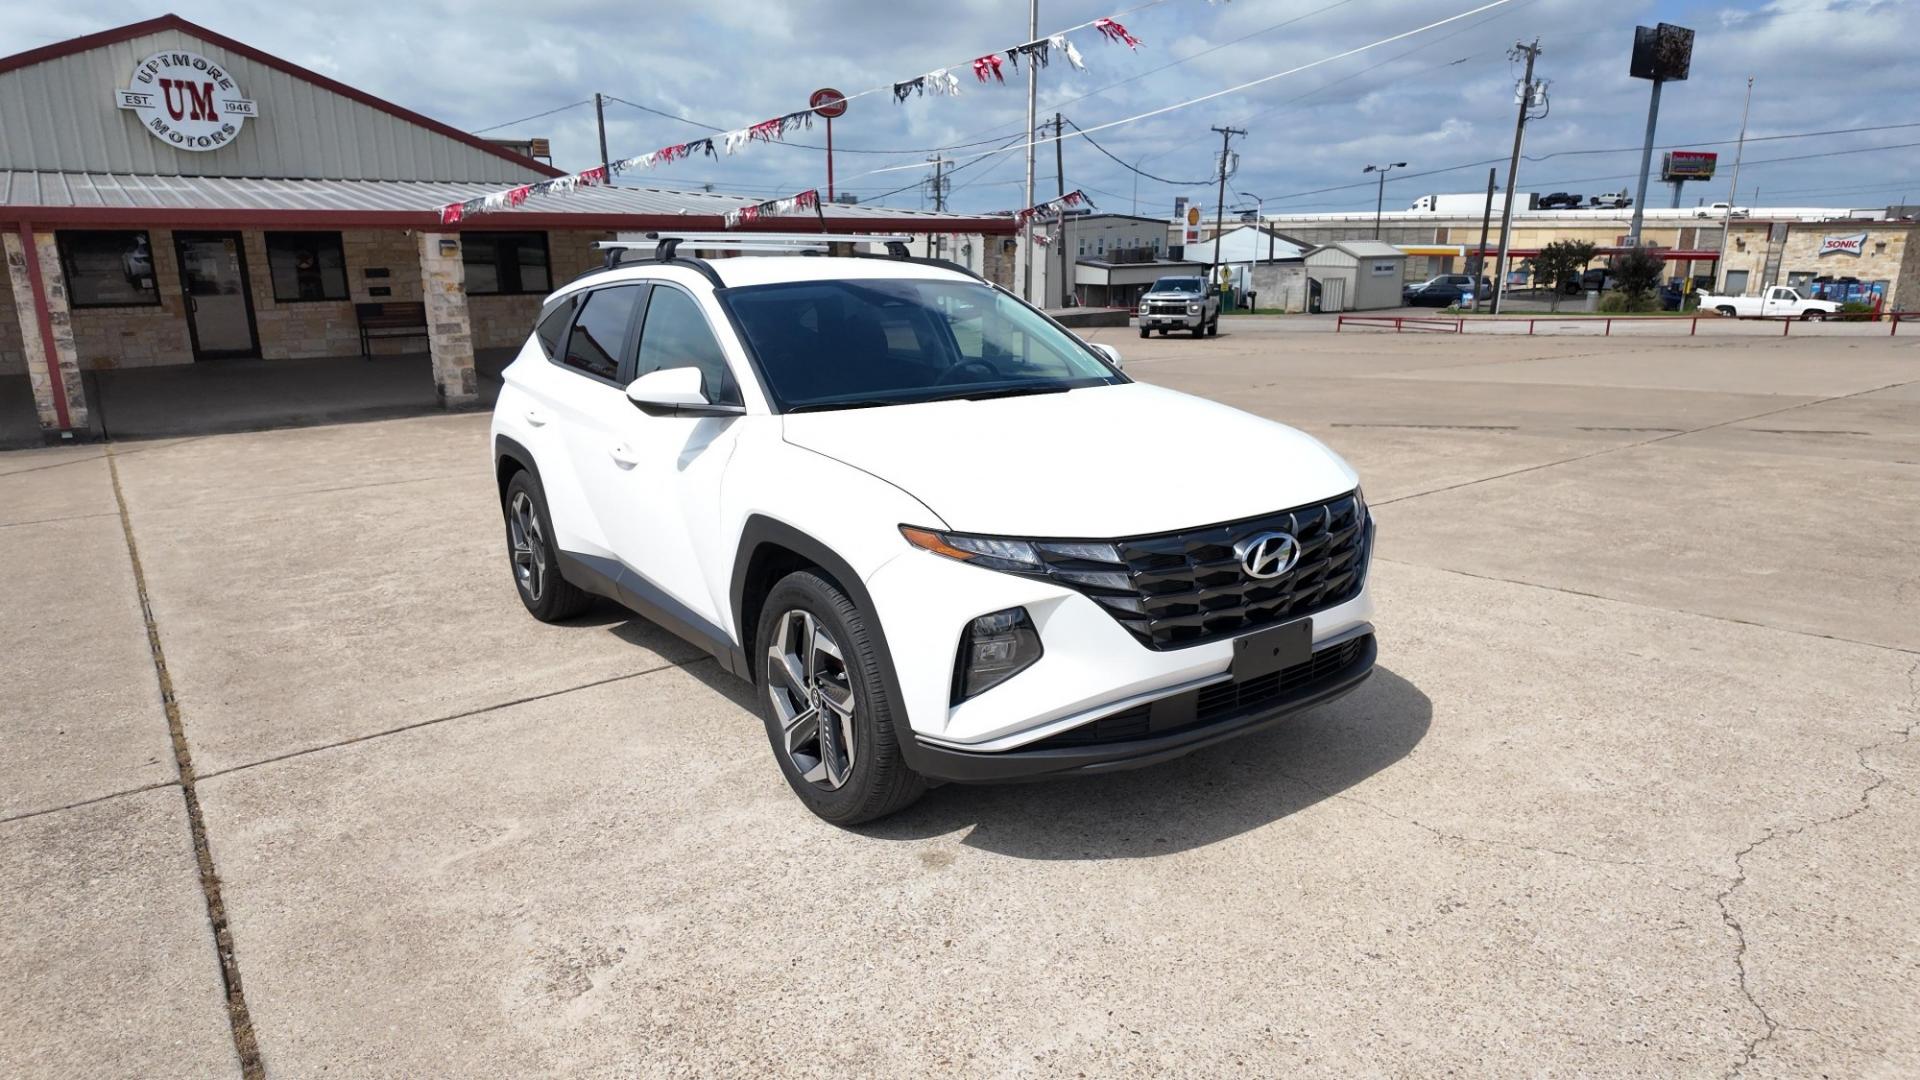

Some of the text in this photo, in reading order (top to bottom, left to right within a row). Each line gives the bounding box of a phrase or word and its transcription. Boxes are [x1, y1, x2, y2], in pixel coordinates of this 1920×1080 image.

[137, 54, 233, 91] UPTMORE
[125, 95, 152, 106] EST.
[159, 78, 219, 122] UM
[225, 102, 251, 112] 1946
[150, 117, 236, 147] MOTORS
[1825, 240, 1859, 248] SONIC
